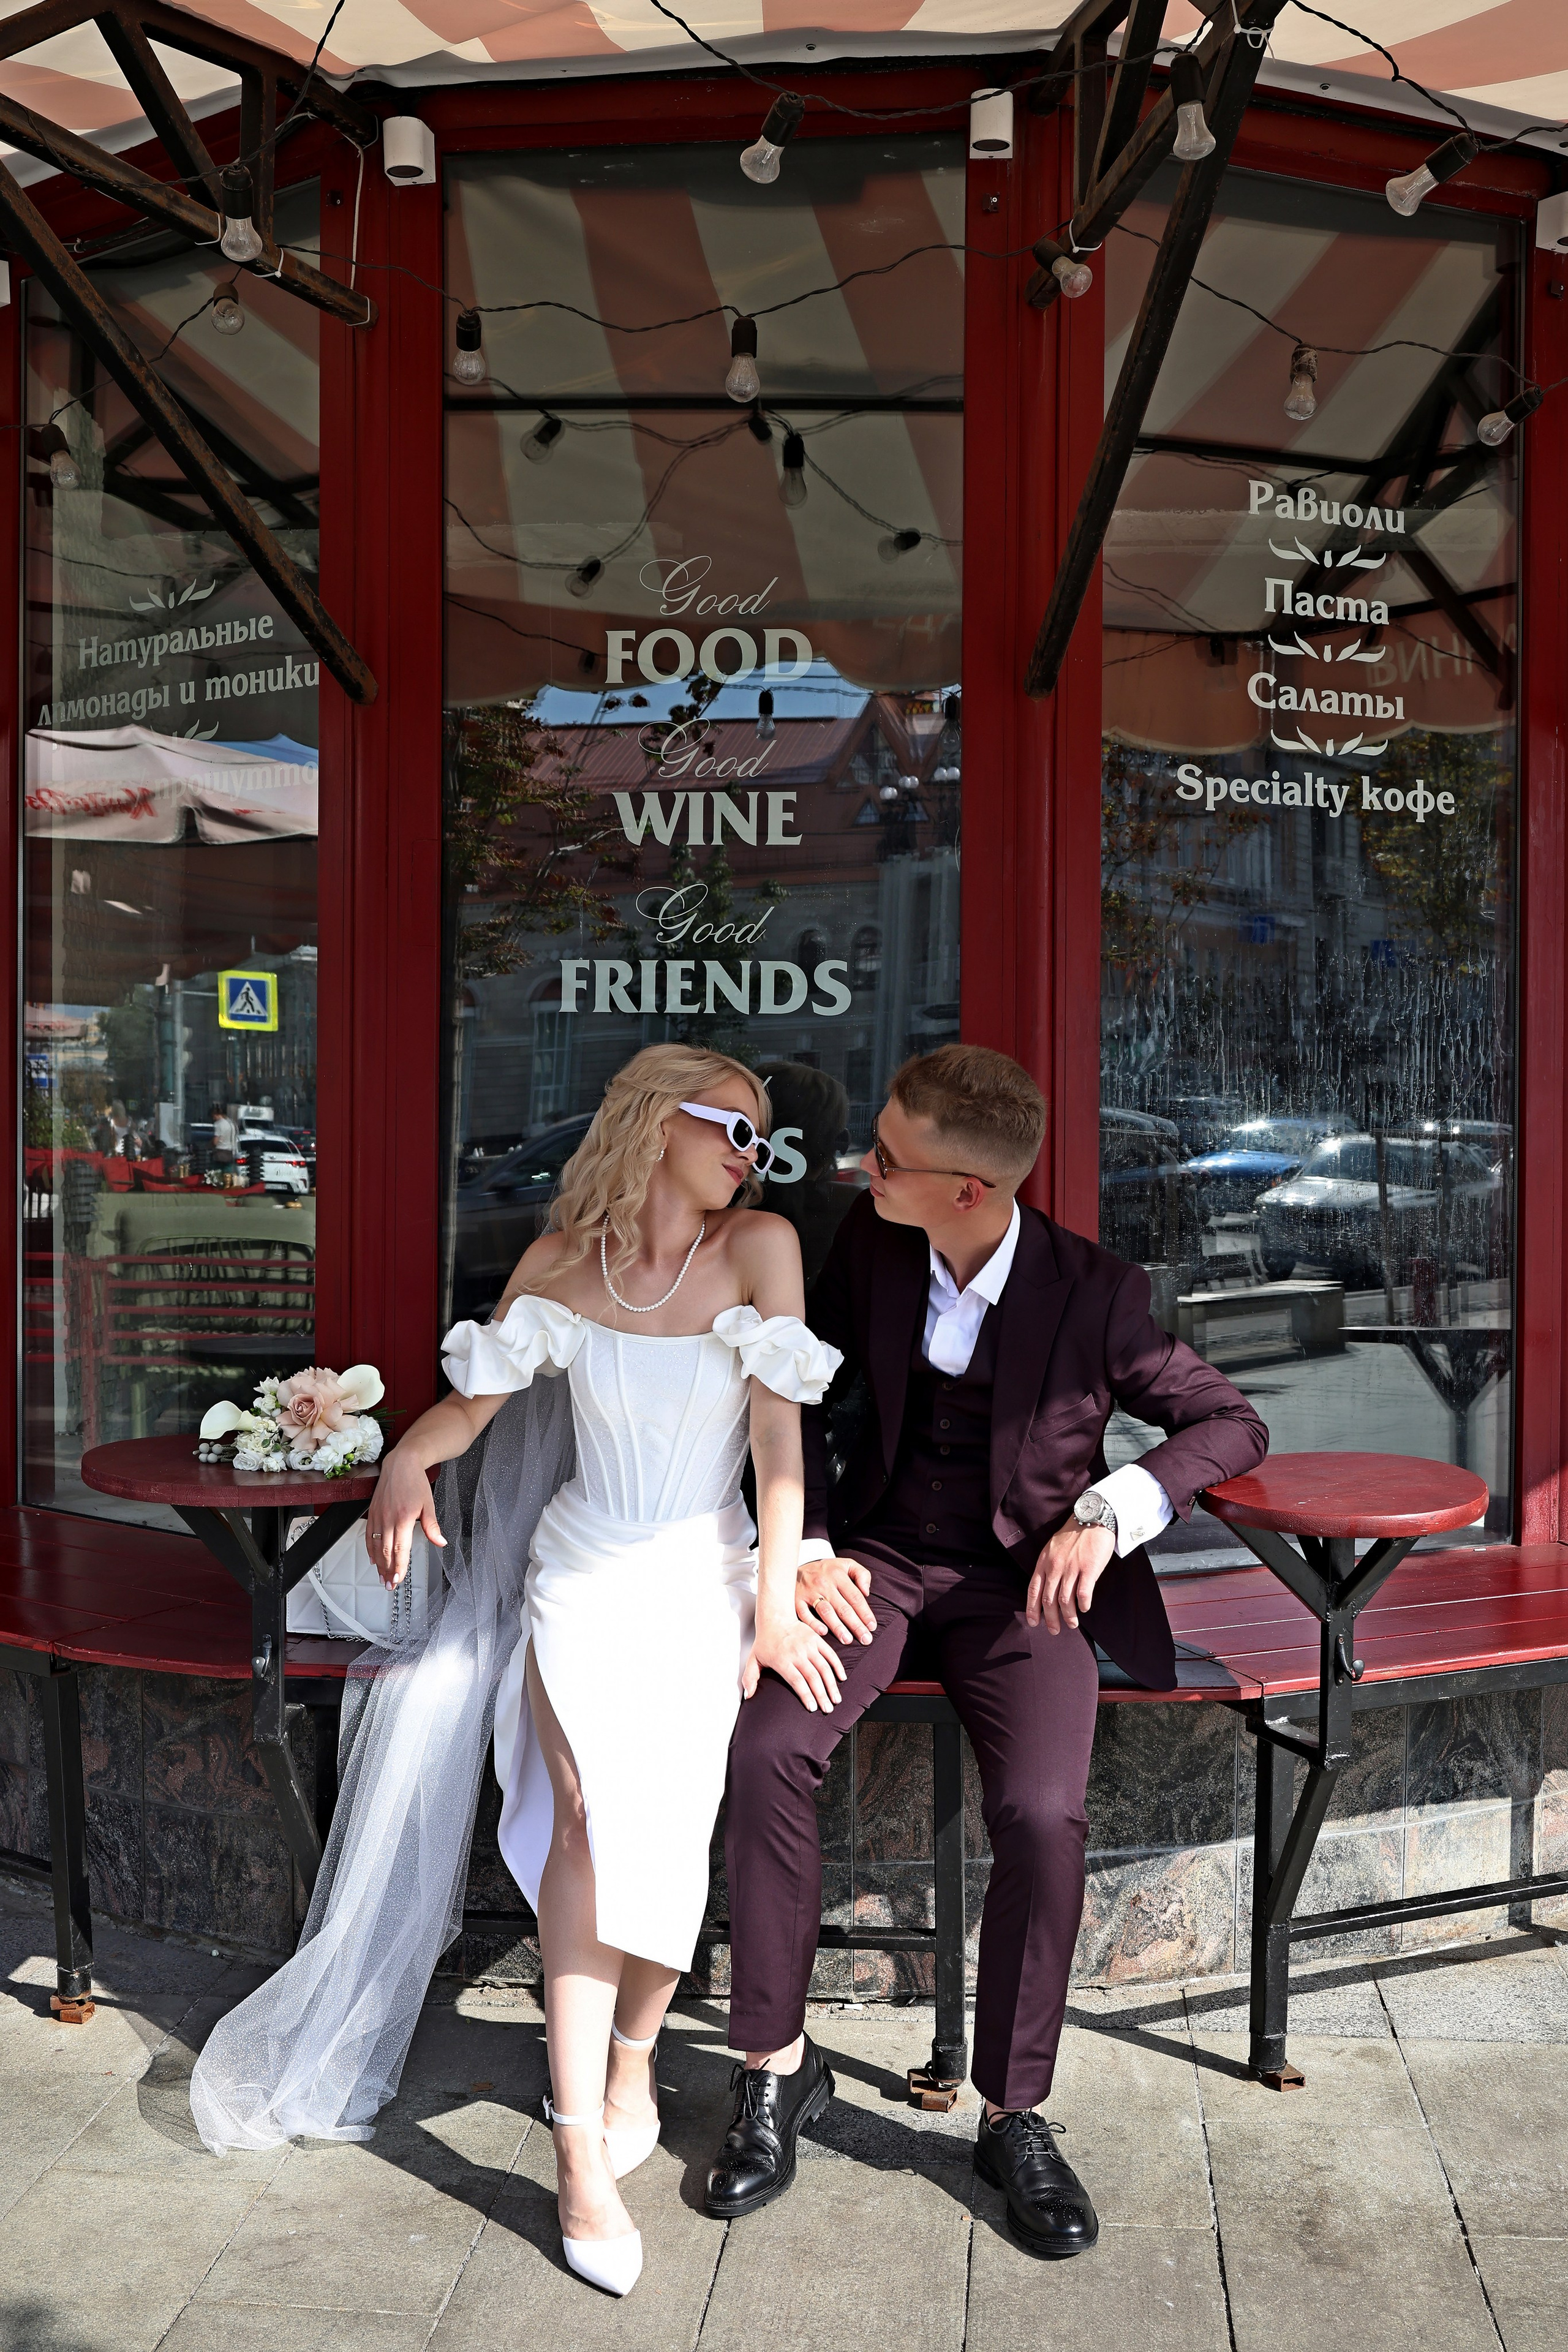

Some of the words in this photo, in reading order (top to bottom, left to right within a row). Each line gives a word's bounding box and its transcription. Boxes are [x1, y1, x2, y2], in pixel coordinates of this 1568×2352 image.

[1248, 480, 1406, 533] Равиоли
[639, 555, 779, 616] Good
[1264, 577, 1390, 625] Паста
[78, 614, 274, 670] Натуральные
[605, 627, 813, 684] FOOD
[179, 680, 196, 704] и
[205, 655, 319, 703] тоники
[1247, 672, 1406, 720] Салаты
[638, 718, 777, 778] Good
[154, 760, 319, 807] прошутто
[1175, 763, 1350, 818] Specialty
[1361, 776, 1456, 823] кофе
[612, 791, 803, 846] WINE
[636, 883, 775, 944] Good
[558, 959, 852, 1016] FRIENDS
